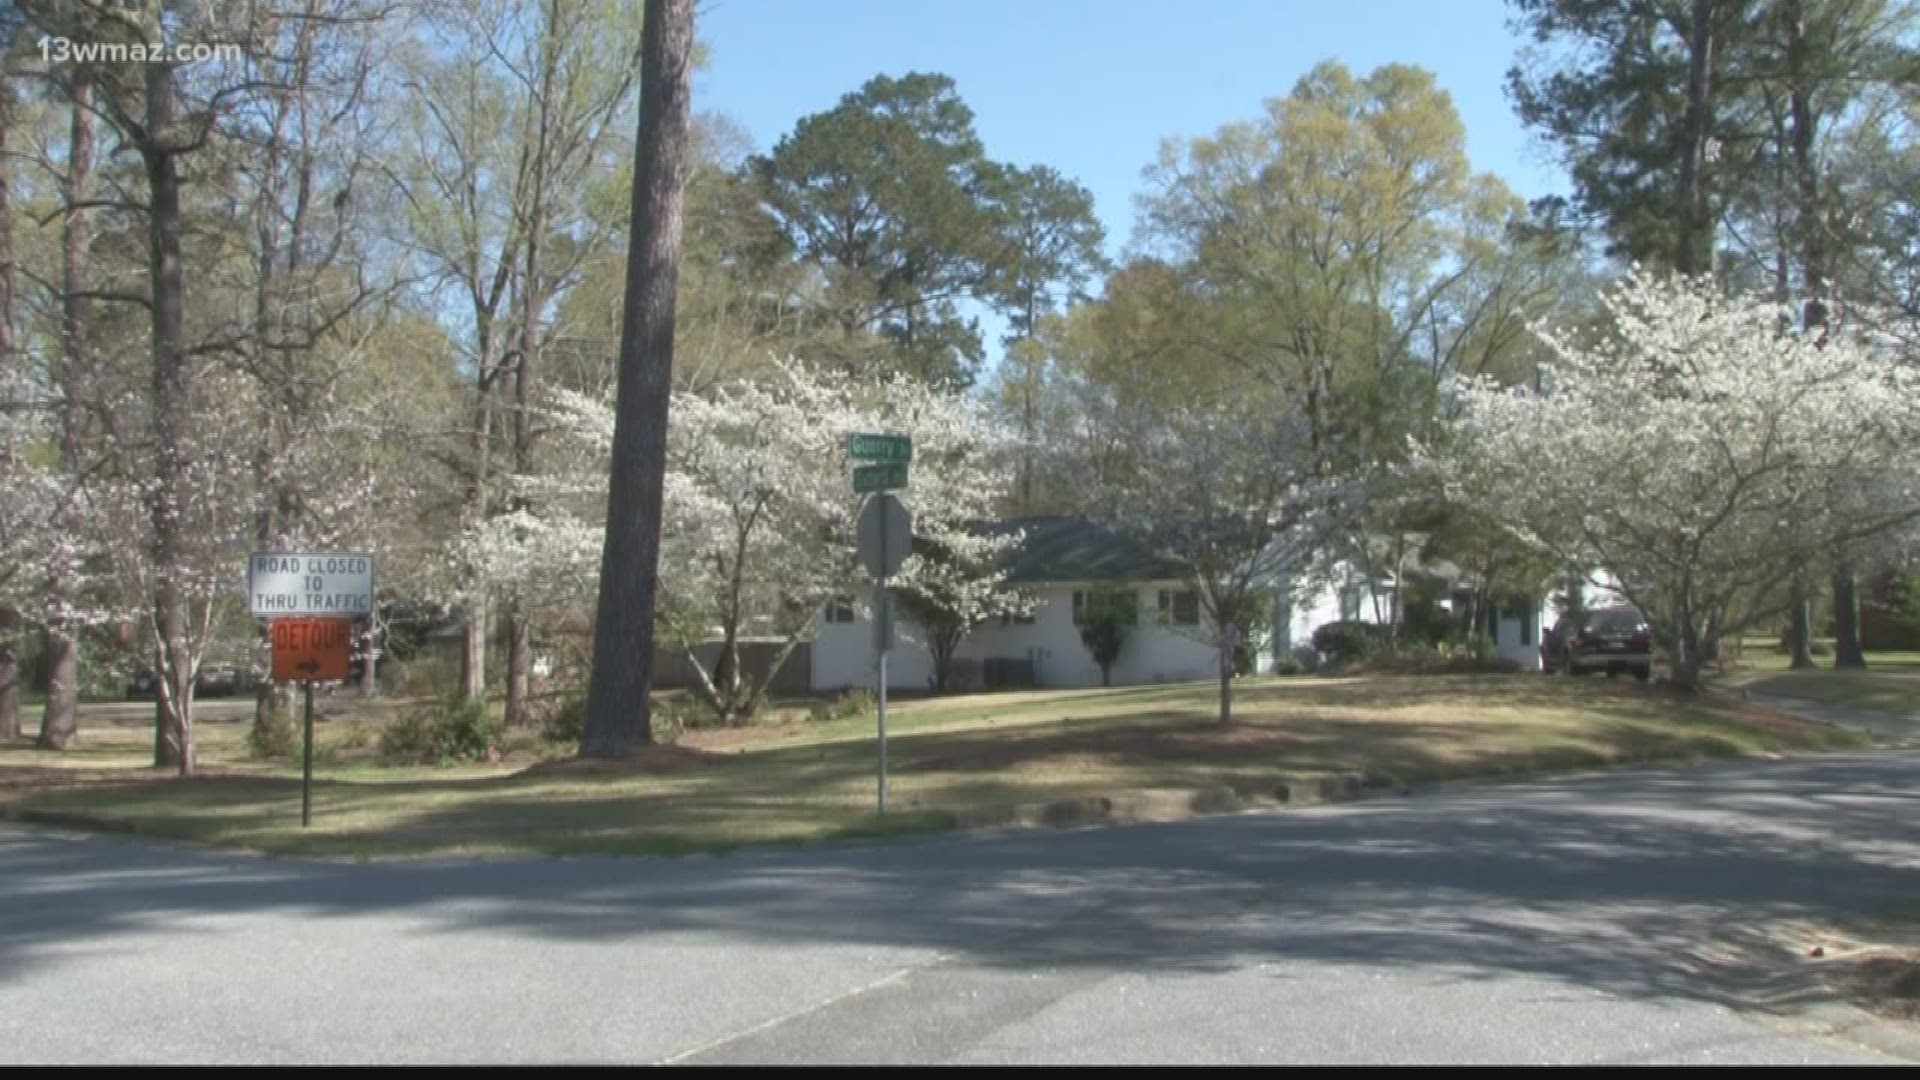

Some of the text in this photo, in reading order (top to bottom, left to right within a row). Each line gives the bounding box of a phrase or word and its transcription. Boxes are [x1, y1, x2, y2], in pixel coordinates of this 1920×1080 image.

[257, 558, 367, 574] ROAD CLOSED
[304, 576, 323, 591] TO
[257, 593, 369, 609] THRU TRAFFIC
[276, 622, 348, 649] DETOUR
